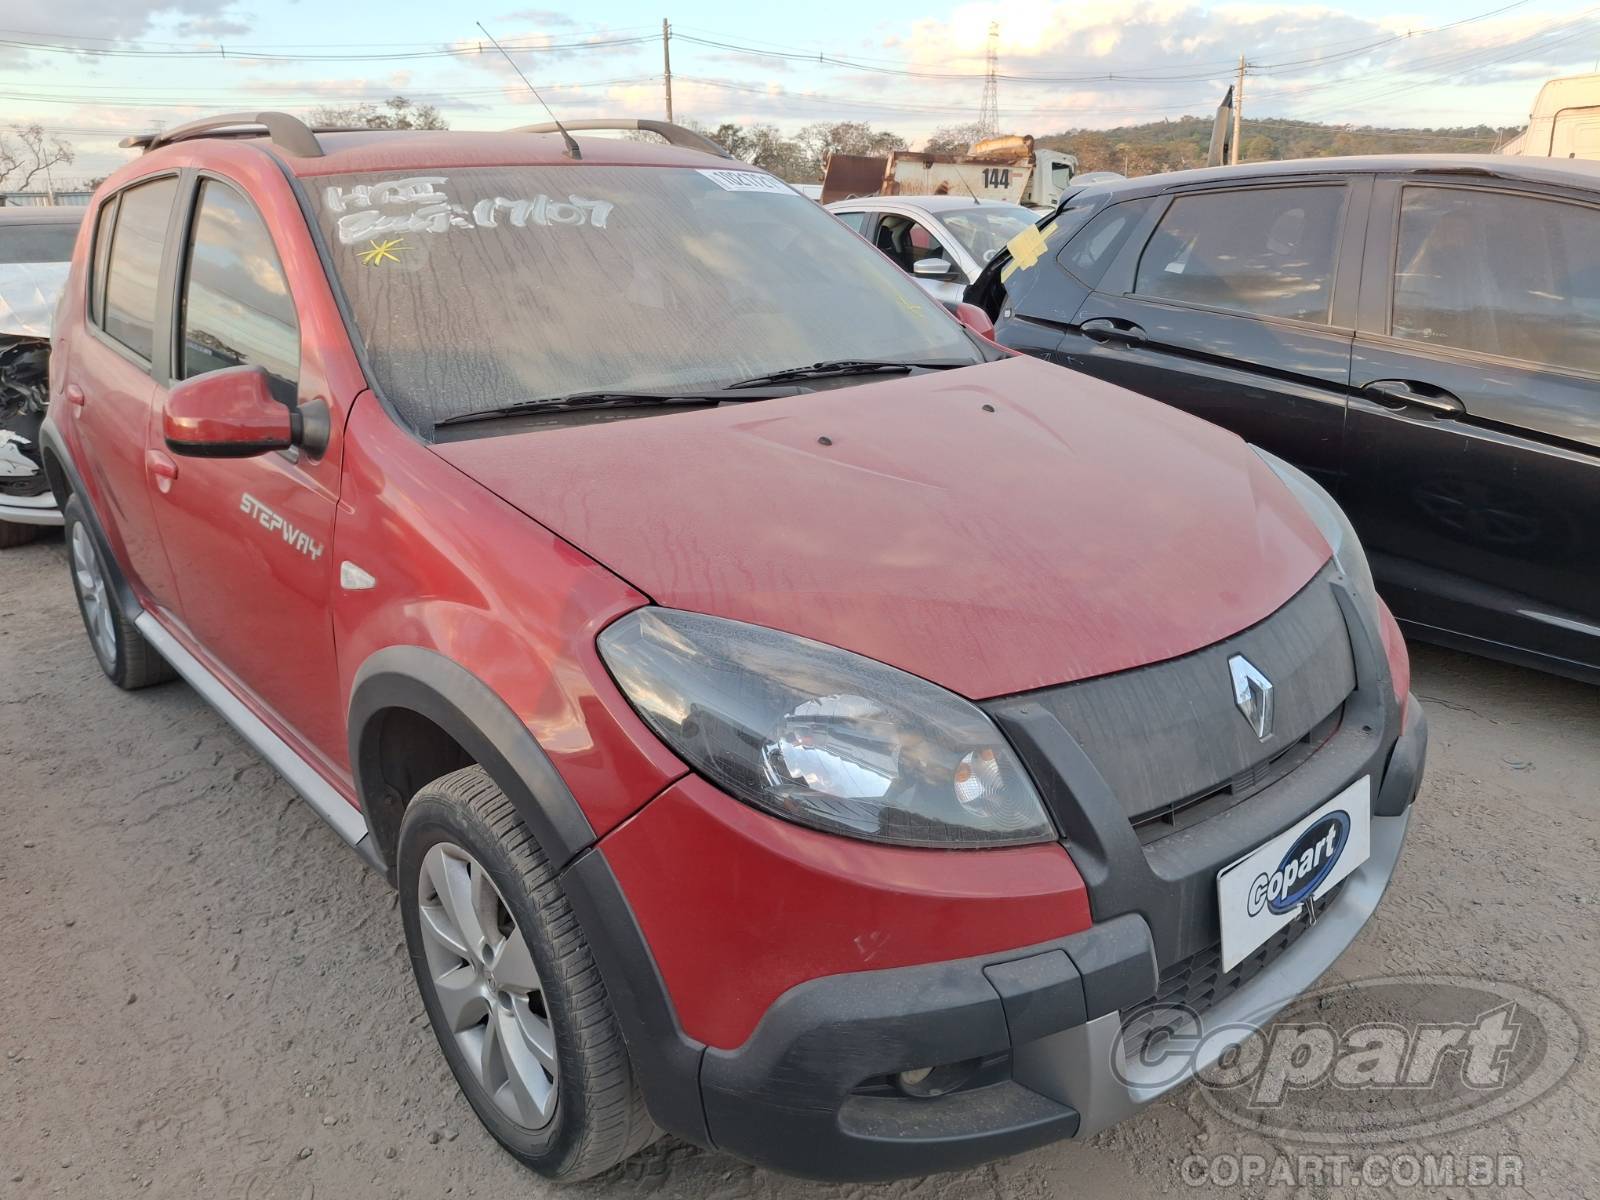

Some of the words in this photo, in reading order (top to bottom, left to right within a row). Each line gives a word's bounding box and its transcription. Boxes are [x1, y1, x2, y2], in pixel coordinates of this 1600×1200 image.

[982, 167, 1010, 189] 144
[240, 492, 325, 561] STEPWAY
[1247, 823, 1337, 918] Copart
